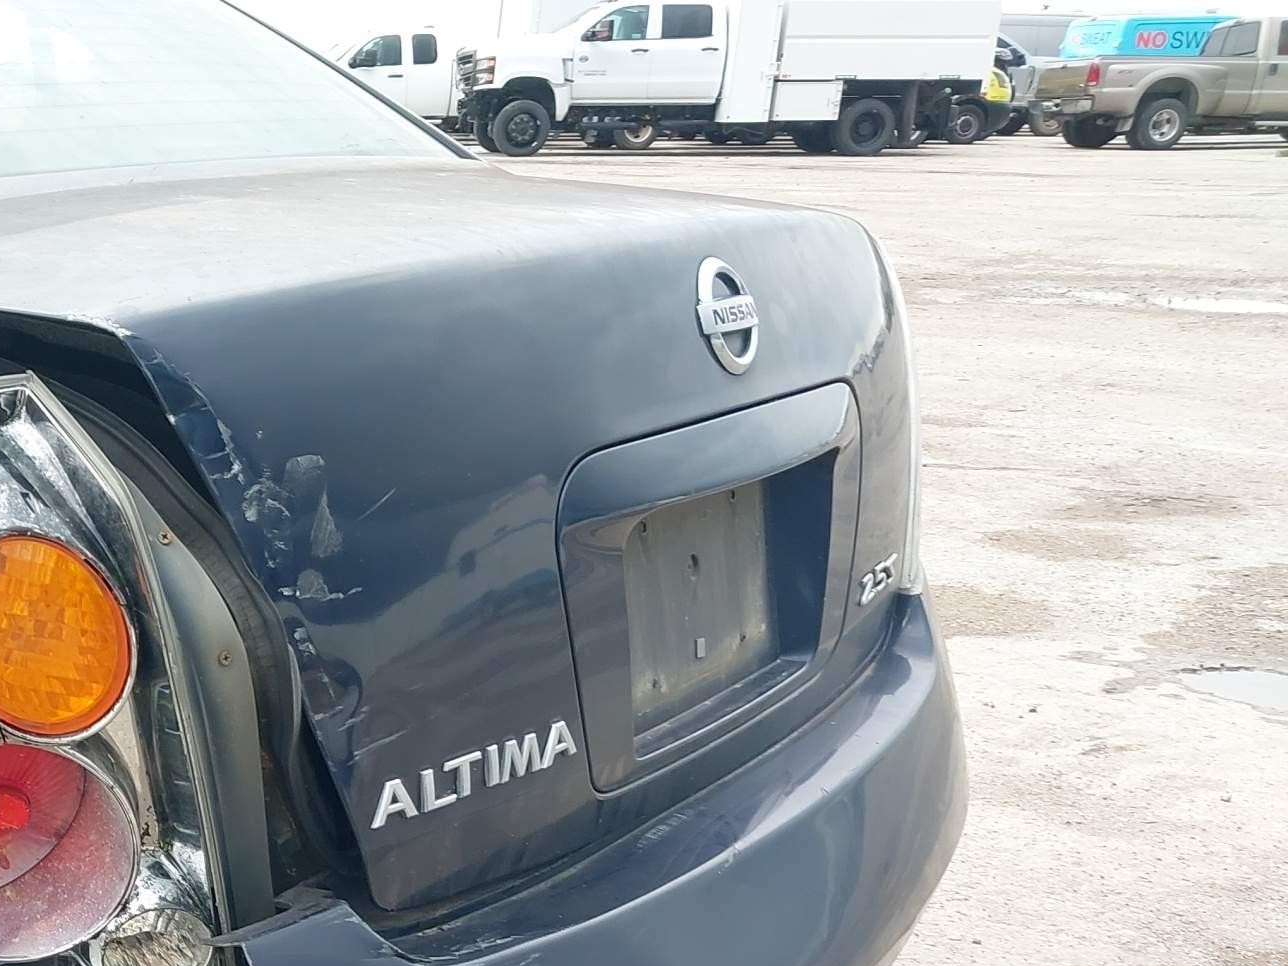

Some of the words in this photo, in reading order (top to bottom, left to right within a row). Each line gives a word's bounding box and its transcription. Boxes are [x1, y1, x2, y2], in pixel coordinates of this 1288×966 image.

[1136, 31, 1167, 49] NO
[712, 302, 757, 326] NISSAN
[370, 720, 577, 829] ALTIMA
